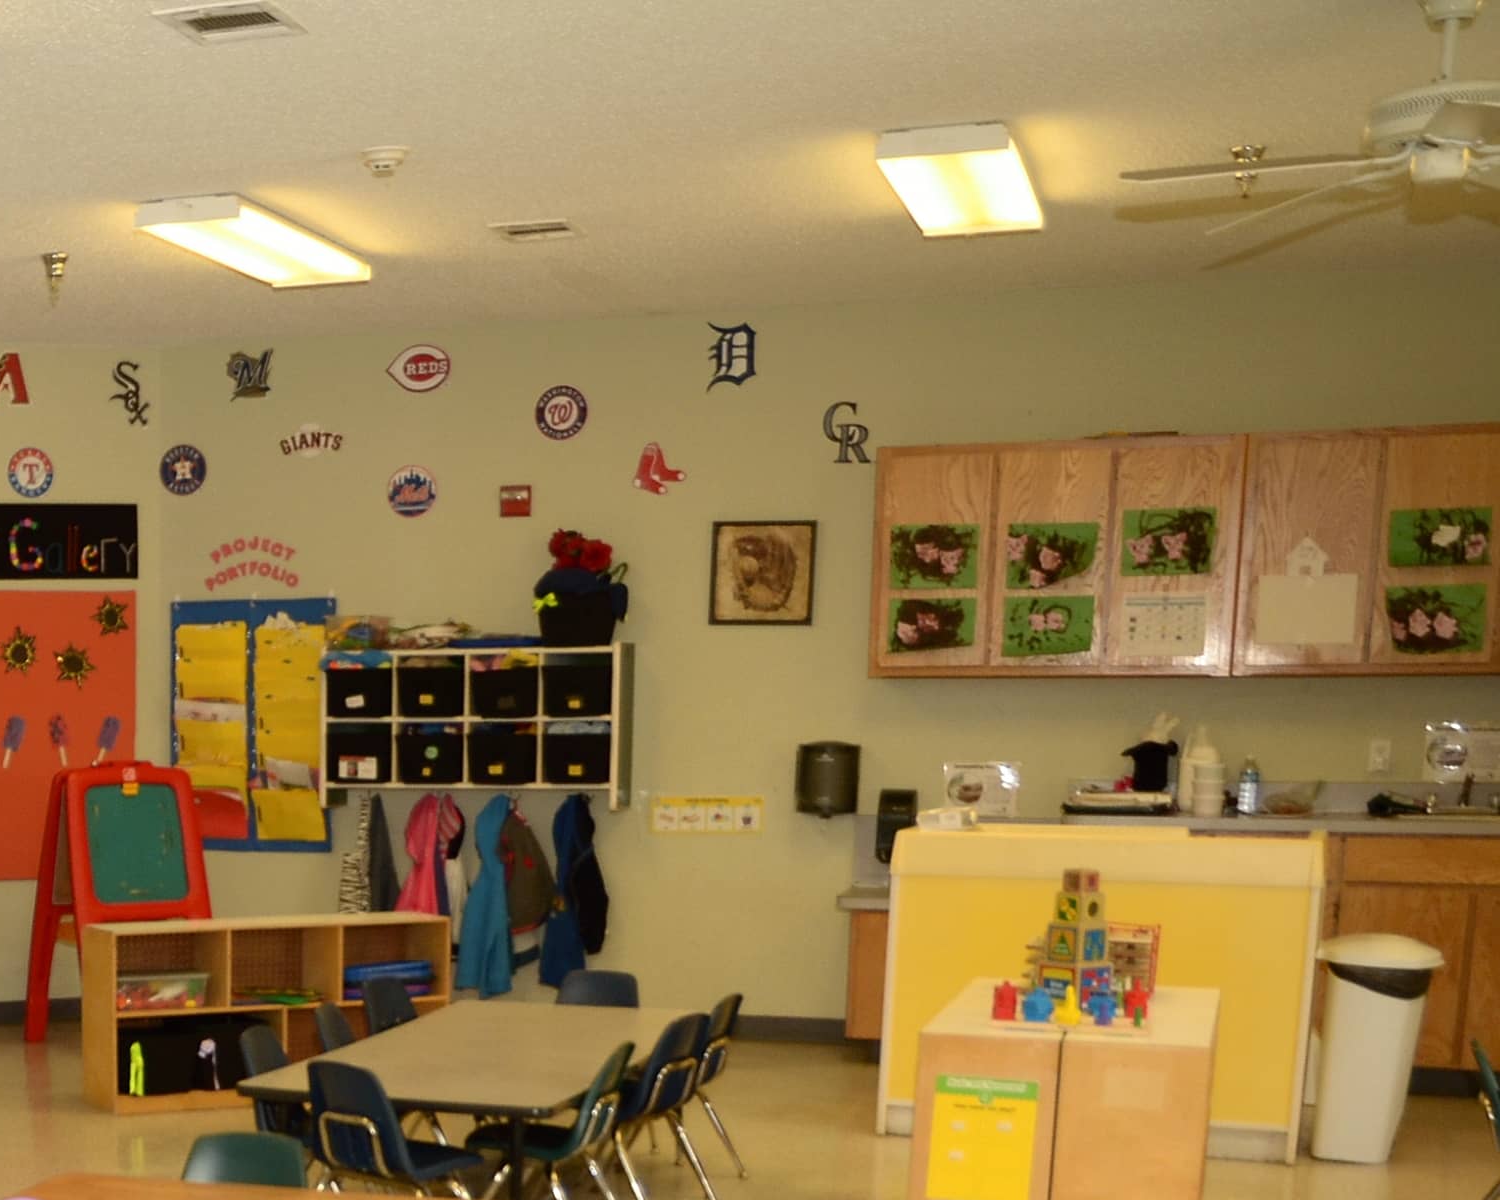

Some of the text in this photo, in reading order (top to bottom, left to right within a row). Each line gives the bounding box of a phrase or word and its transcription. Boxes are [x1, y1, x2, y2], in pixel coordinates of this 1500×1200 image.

[405, 360, 449, 376] REDS
[279, 431, 344, 456] GIANTS
[209, 535, 296, 565] PROJECT
[204, 560, 299, 592] PORTFOLIO
